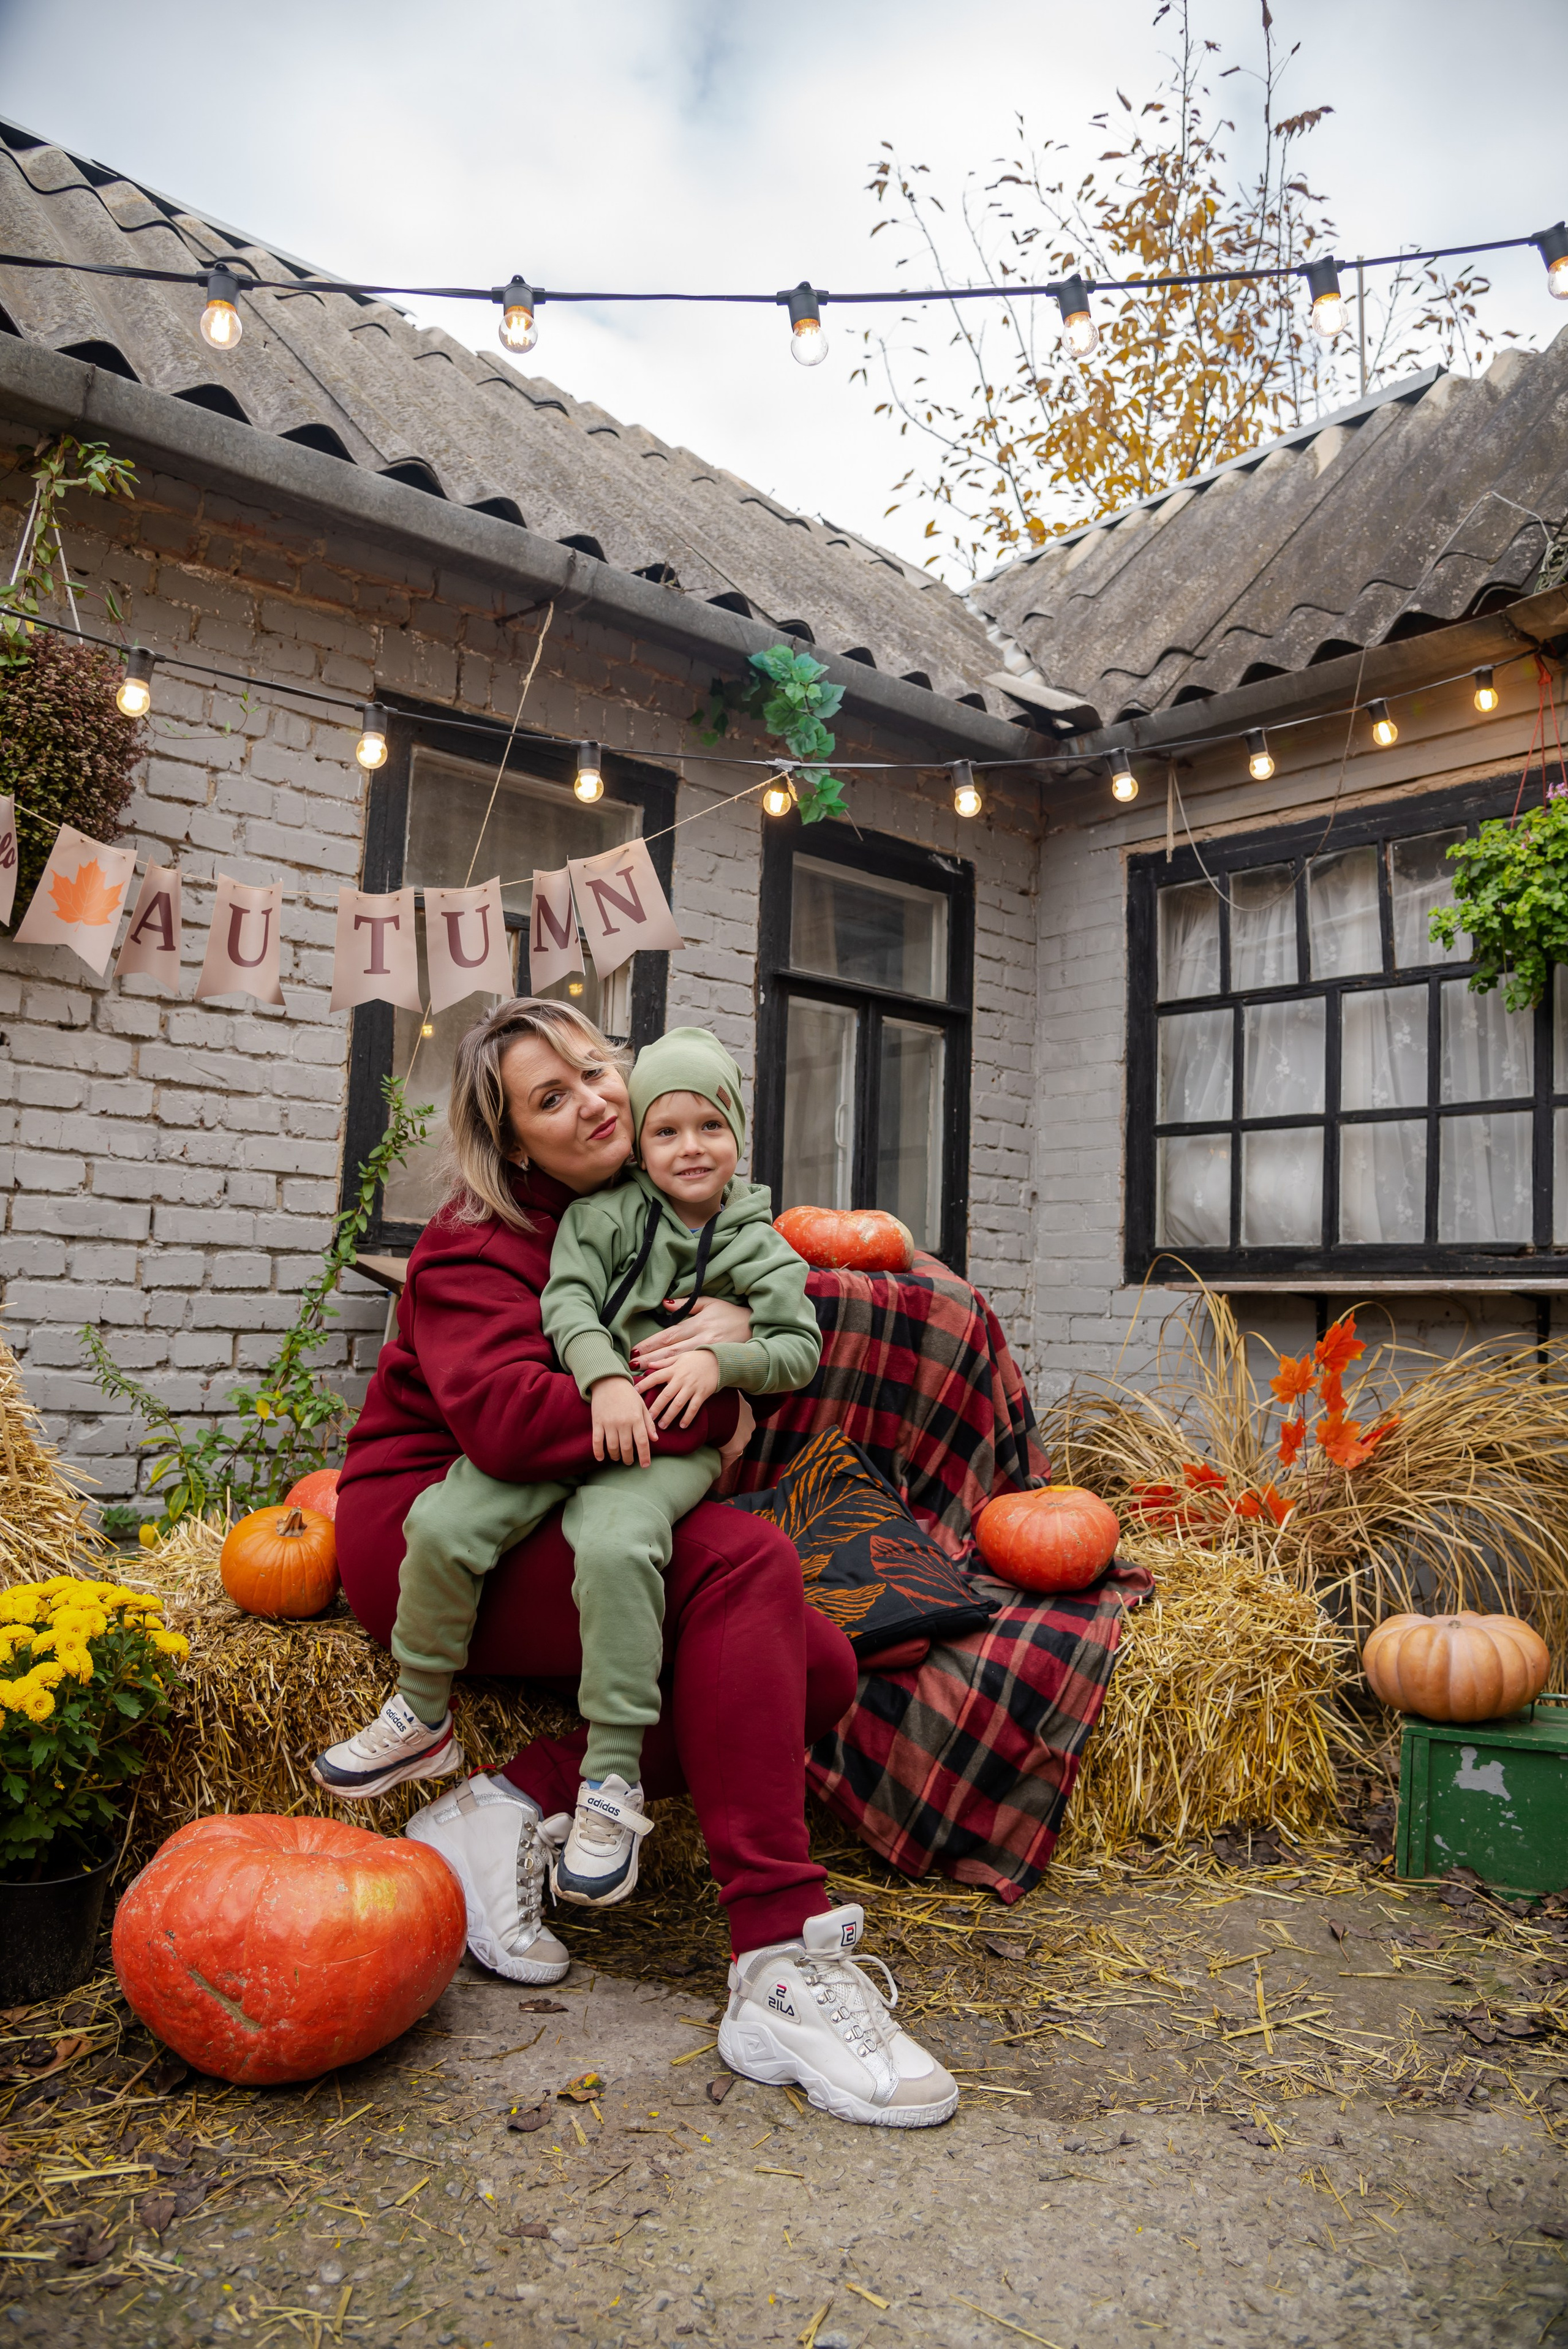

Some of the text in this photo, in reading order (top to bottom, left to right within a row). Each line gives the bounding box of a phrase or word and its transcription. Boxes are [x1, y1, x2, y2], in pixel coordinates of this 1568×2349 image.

[130, 865, 647, 975] AUTUMN
[386, 1709, 406, 1732] adidas
[587, 1798, 620, 1816] adidas
